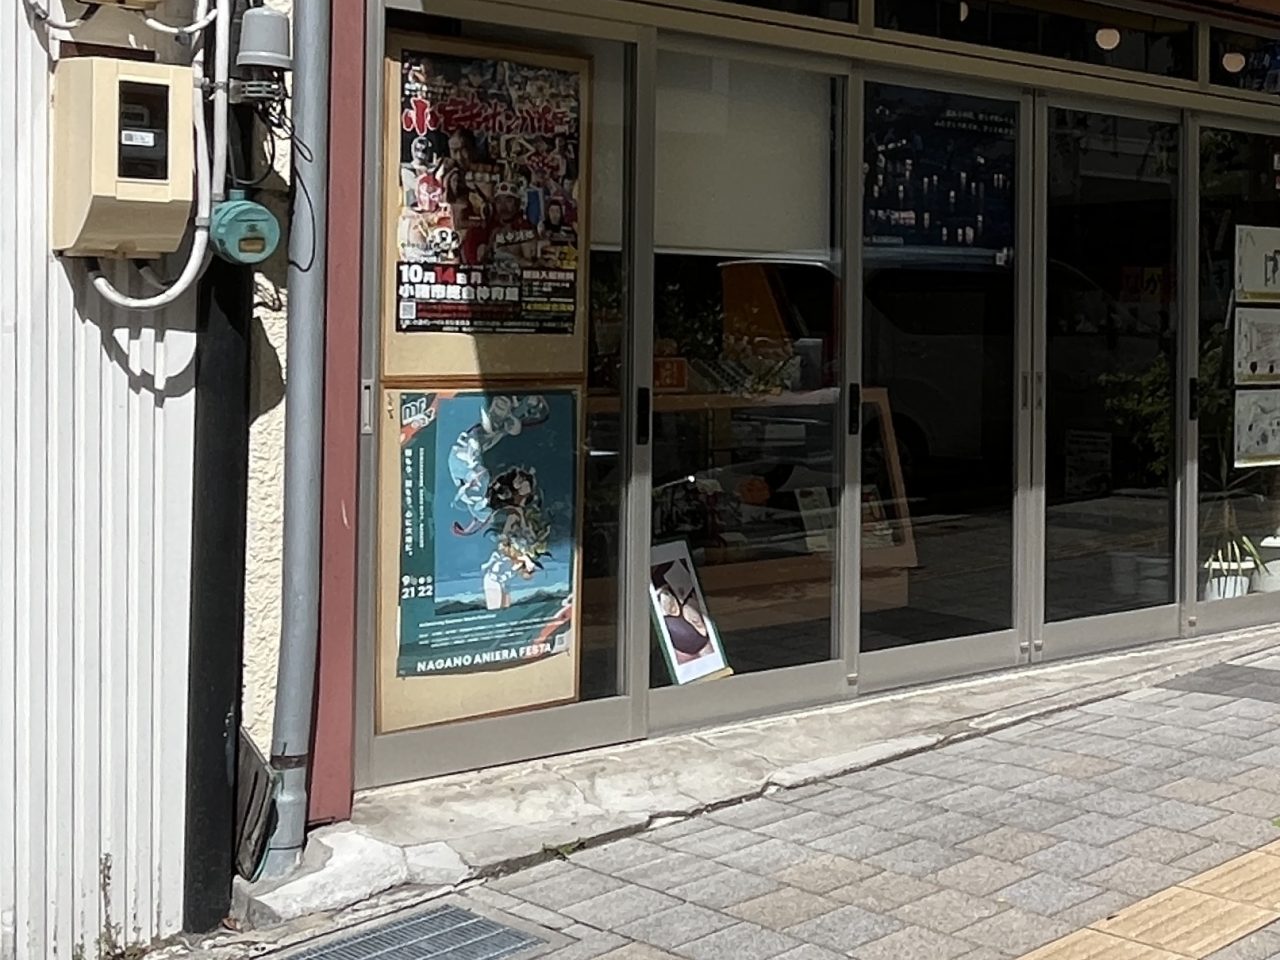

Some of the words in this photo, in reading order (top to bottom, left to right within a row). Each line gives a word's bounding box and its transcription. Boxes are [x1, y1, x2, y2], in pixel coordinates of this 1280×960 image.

[401, 586, 415, 599] 21
[417, 585, 433, 597] 22
[416, 654, 472, 673] NAGANO
[473, 647, 518, 665] ANIERA
[519, 643, 551, 657] FESTA
